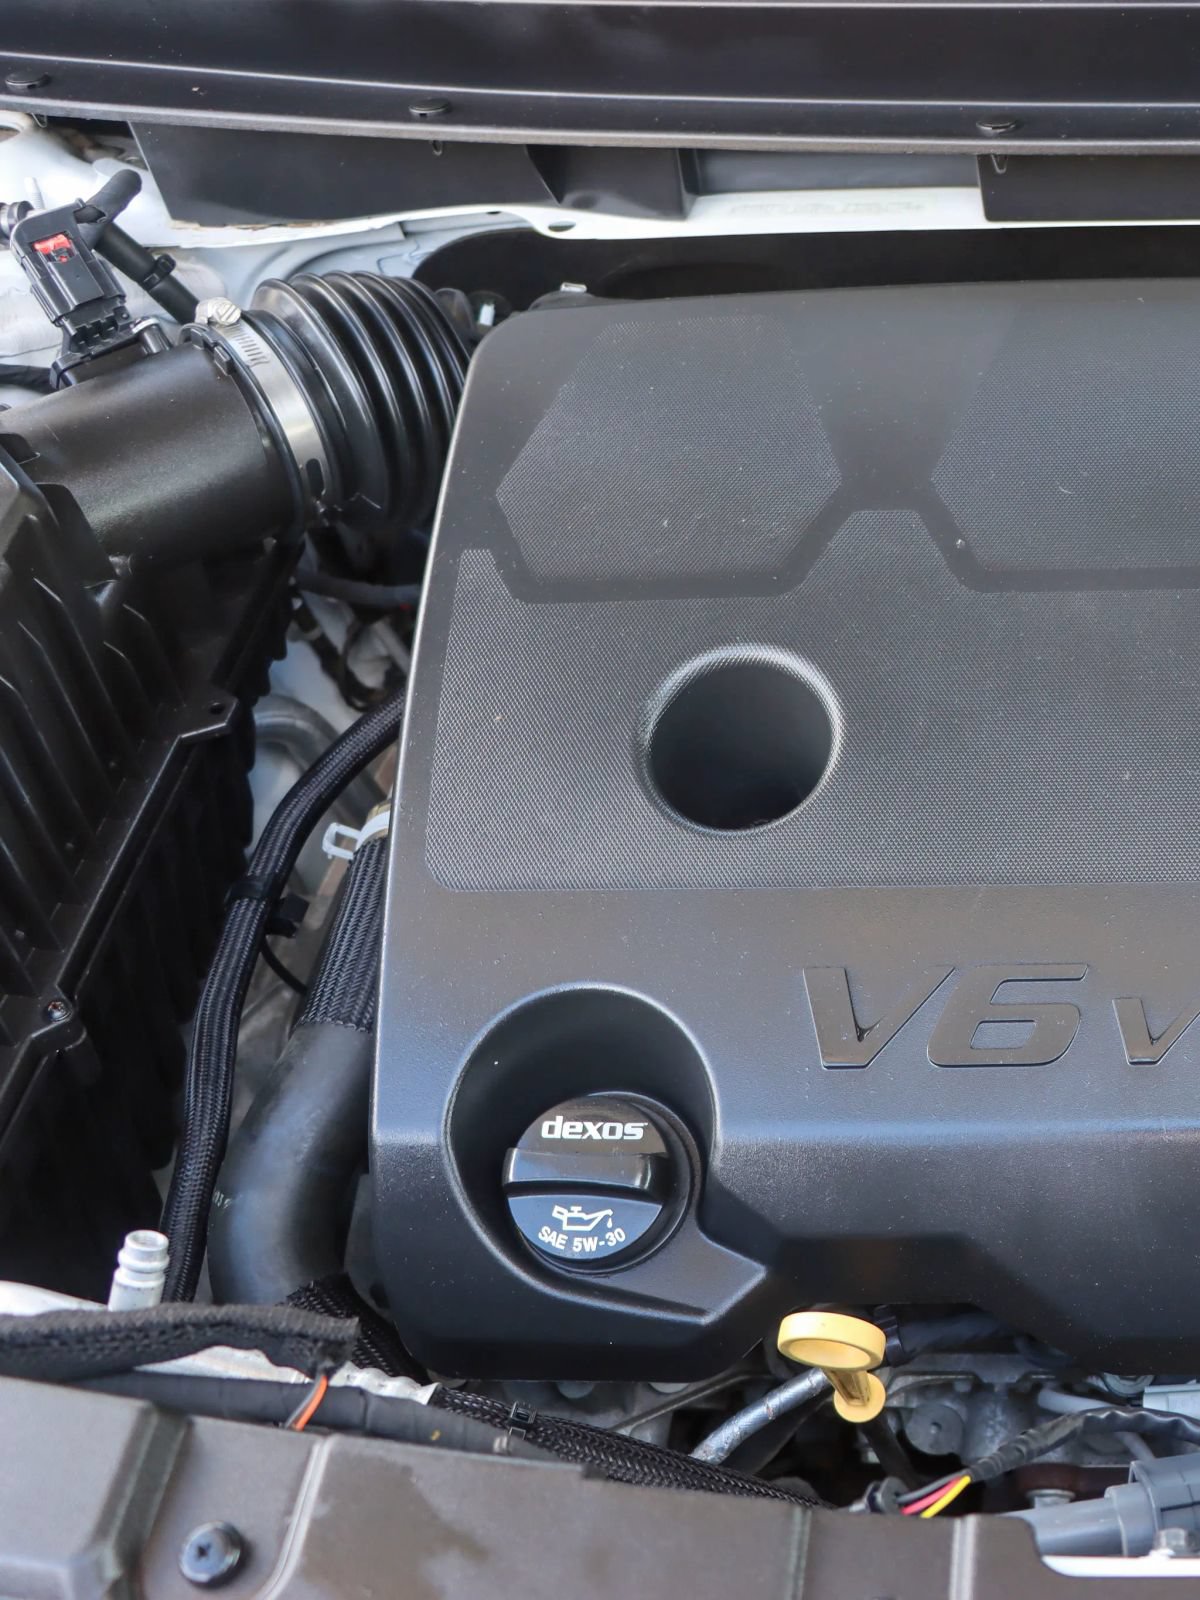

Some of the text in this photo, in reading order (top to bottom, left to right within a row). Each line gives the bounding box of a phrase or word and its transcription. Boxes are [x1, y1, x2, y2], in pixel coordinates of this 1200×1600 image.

[802, 963, 1089, 1071] V6
[541, 1116, 647, 1141] dexos
[538, 1226, 626, 1252] SAE 5W-30
